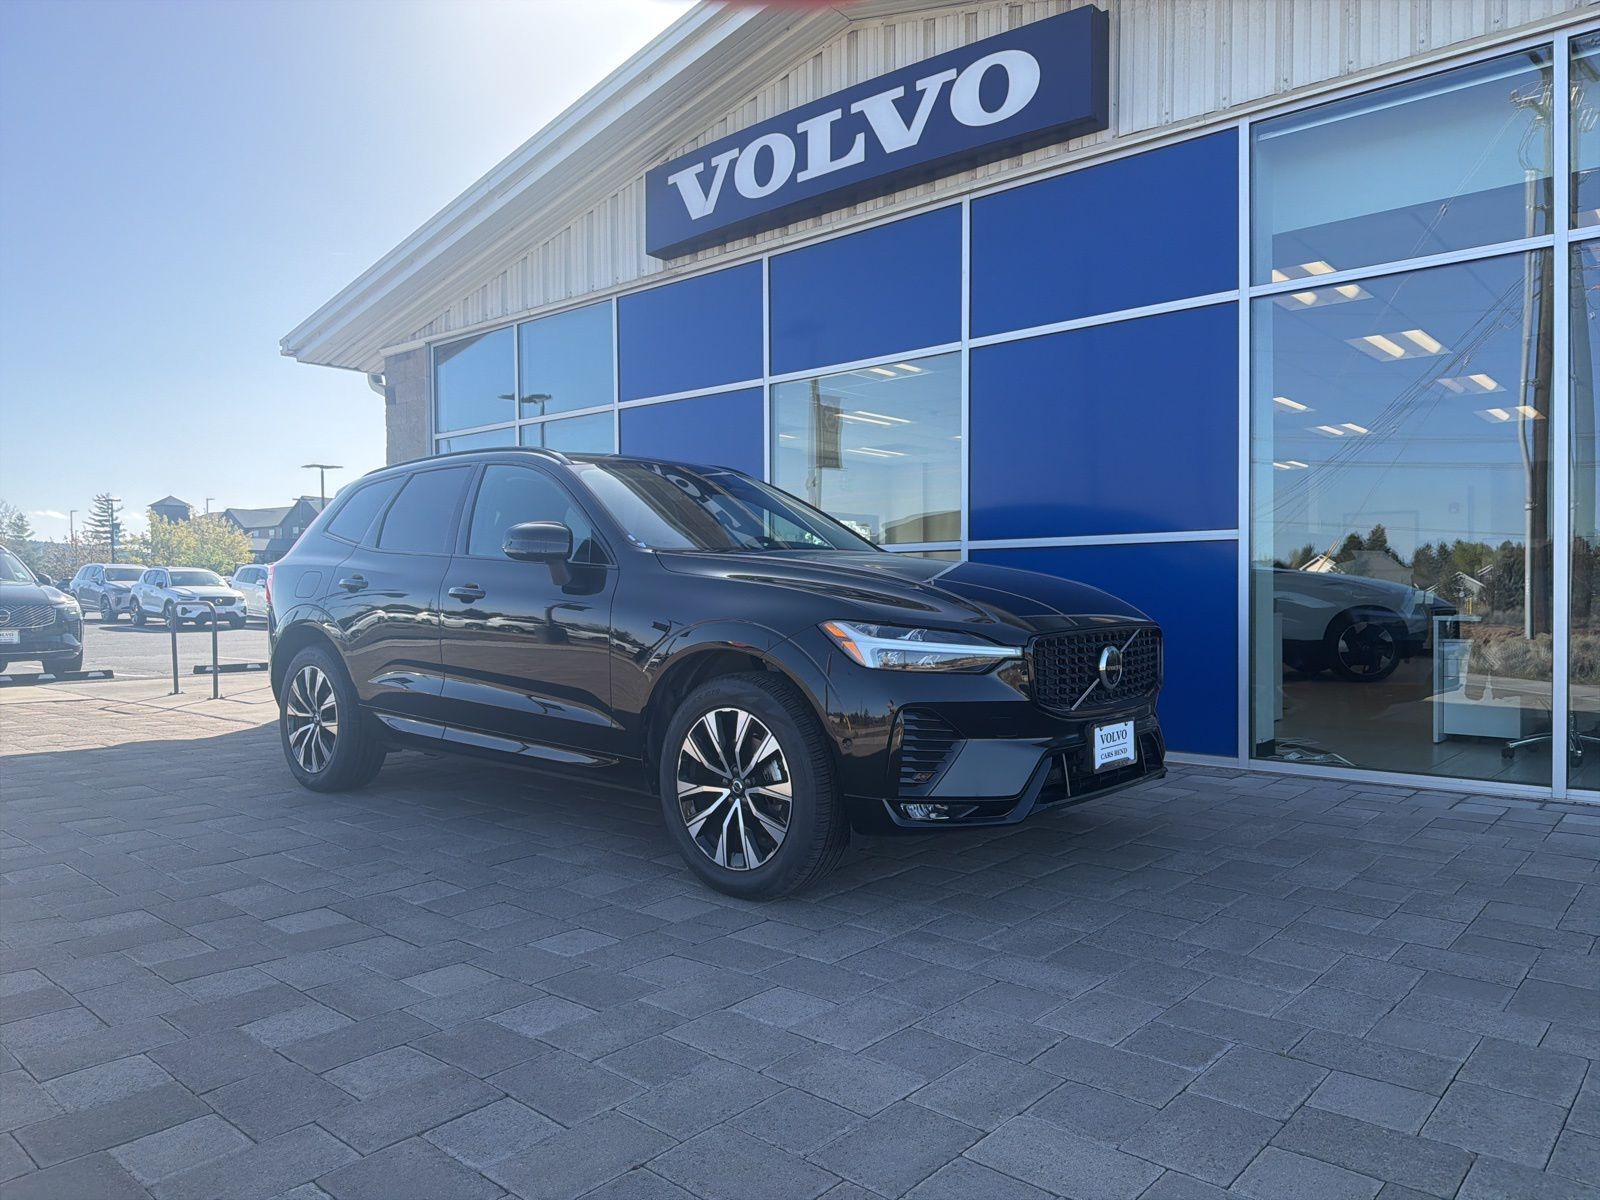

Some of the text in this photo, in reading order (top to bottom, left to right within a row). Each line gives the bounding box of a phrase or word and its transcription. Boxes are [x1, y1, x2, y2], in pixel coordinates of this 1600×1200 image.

[667, 49, 1041, 221] VOLVO
[1100, 729, 1128, 745] VOLVO
[1101, 748, 1128, 760] CARS BEND
